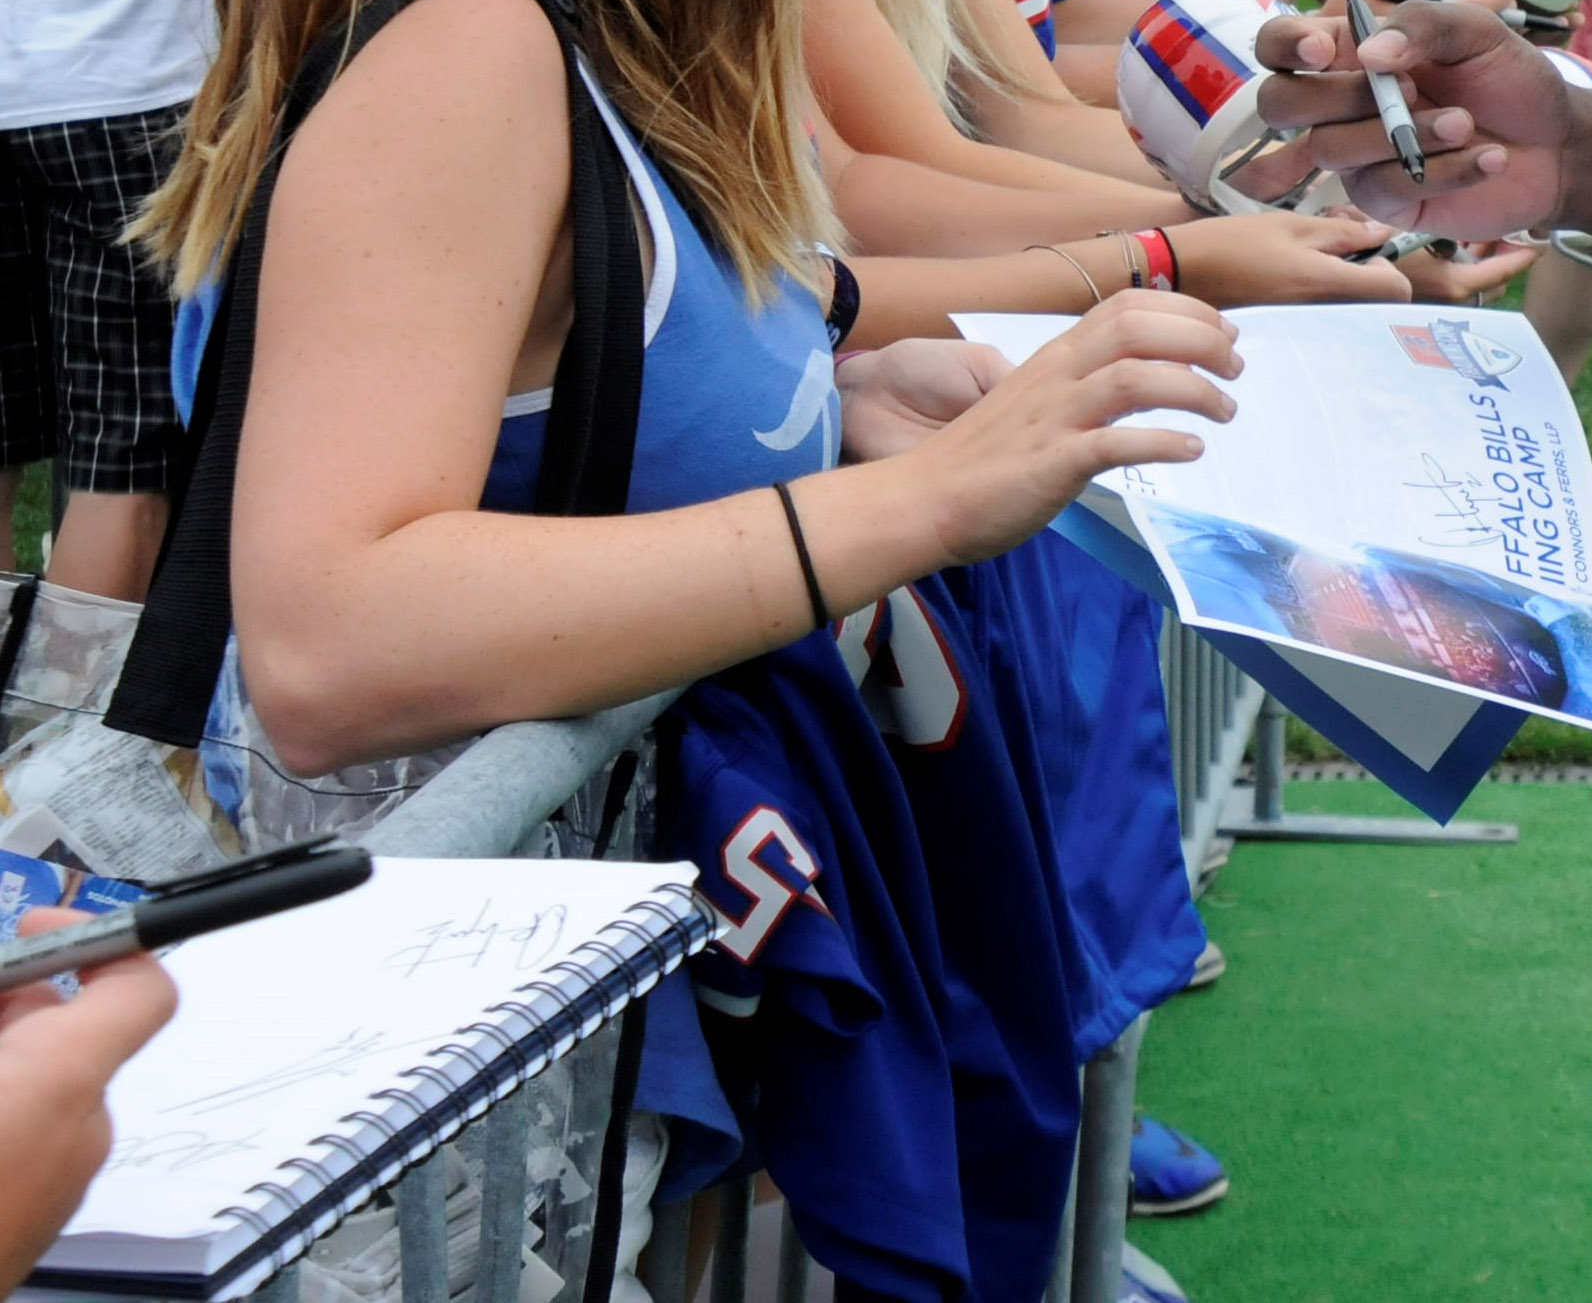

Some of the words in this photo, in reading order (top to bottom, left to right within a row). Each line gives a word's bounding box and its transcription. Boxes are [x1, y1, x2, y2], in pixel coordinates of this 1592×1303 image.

[1469, 394, 1513, 464] BILLS
[1543, 422, 1561, 446] LLP
[1512, 426, 1552, 509] CAMP
[1562, 497, 1576, 507] &
[1568, 516, 1588, 584] CONNORS
